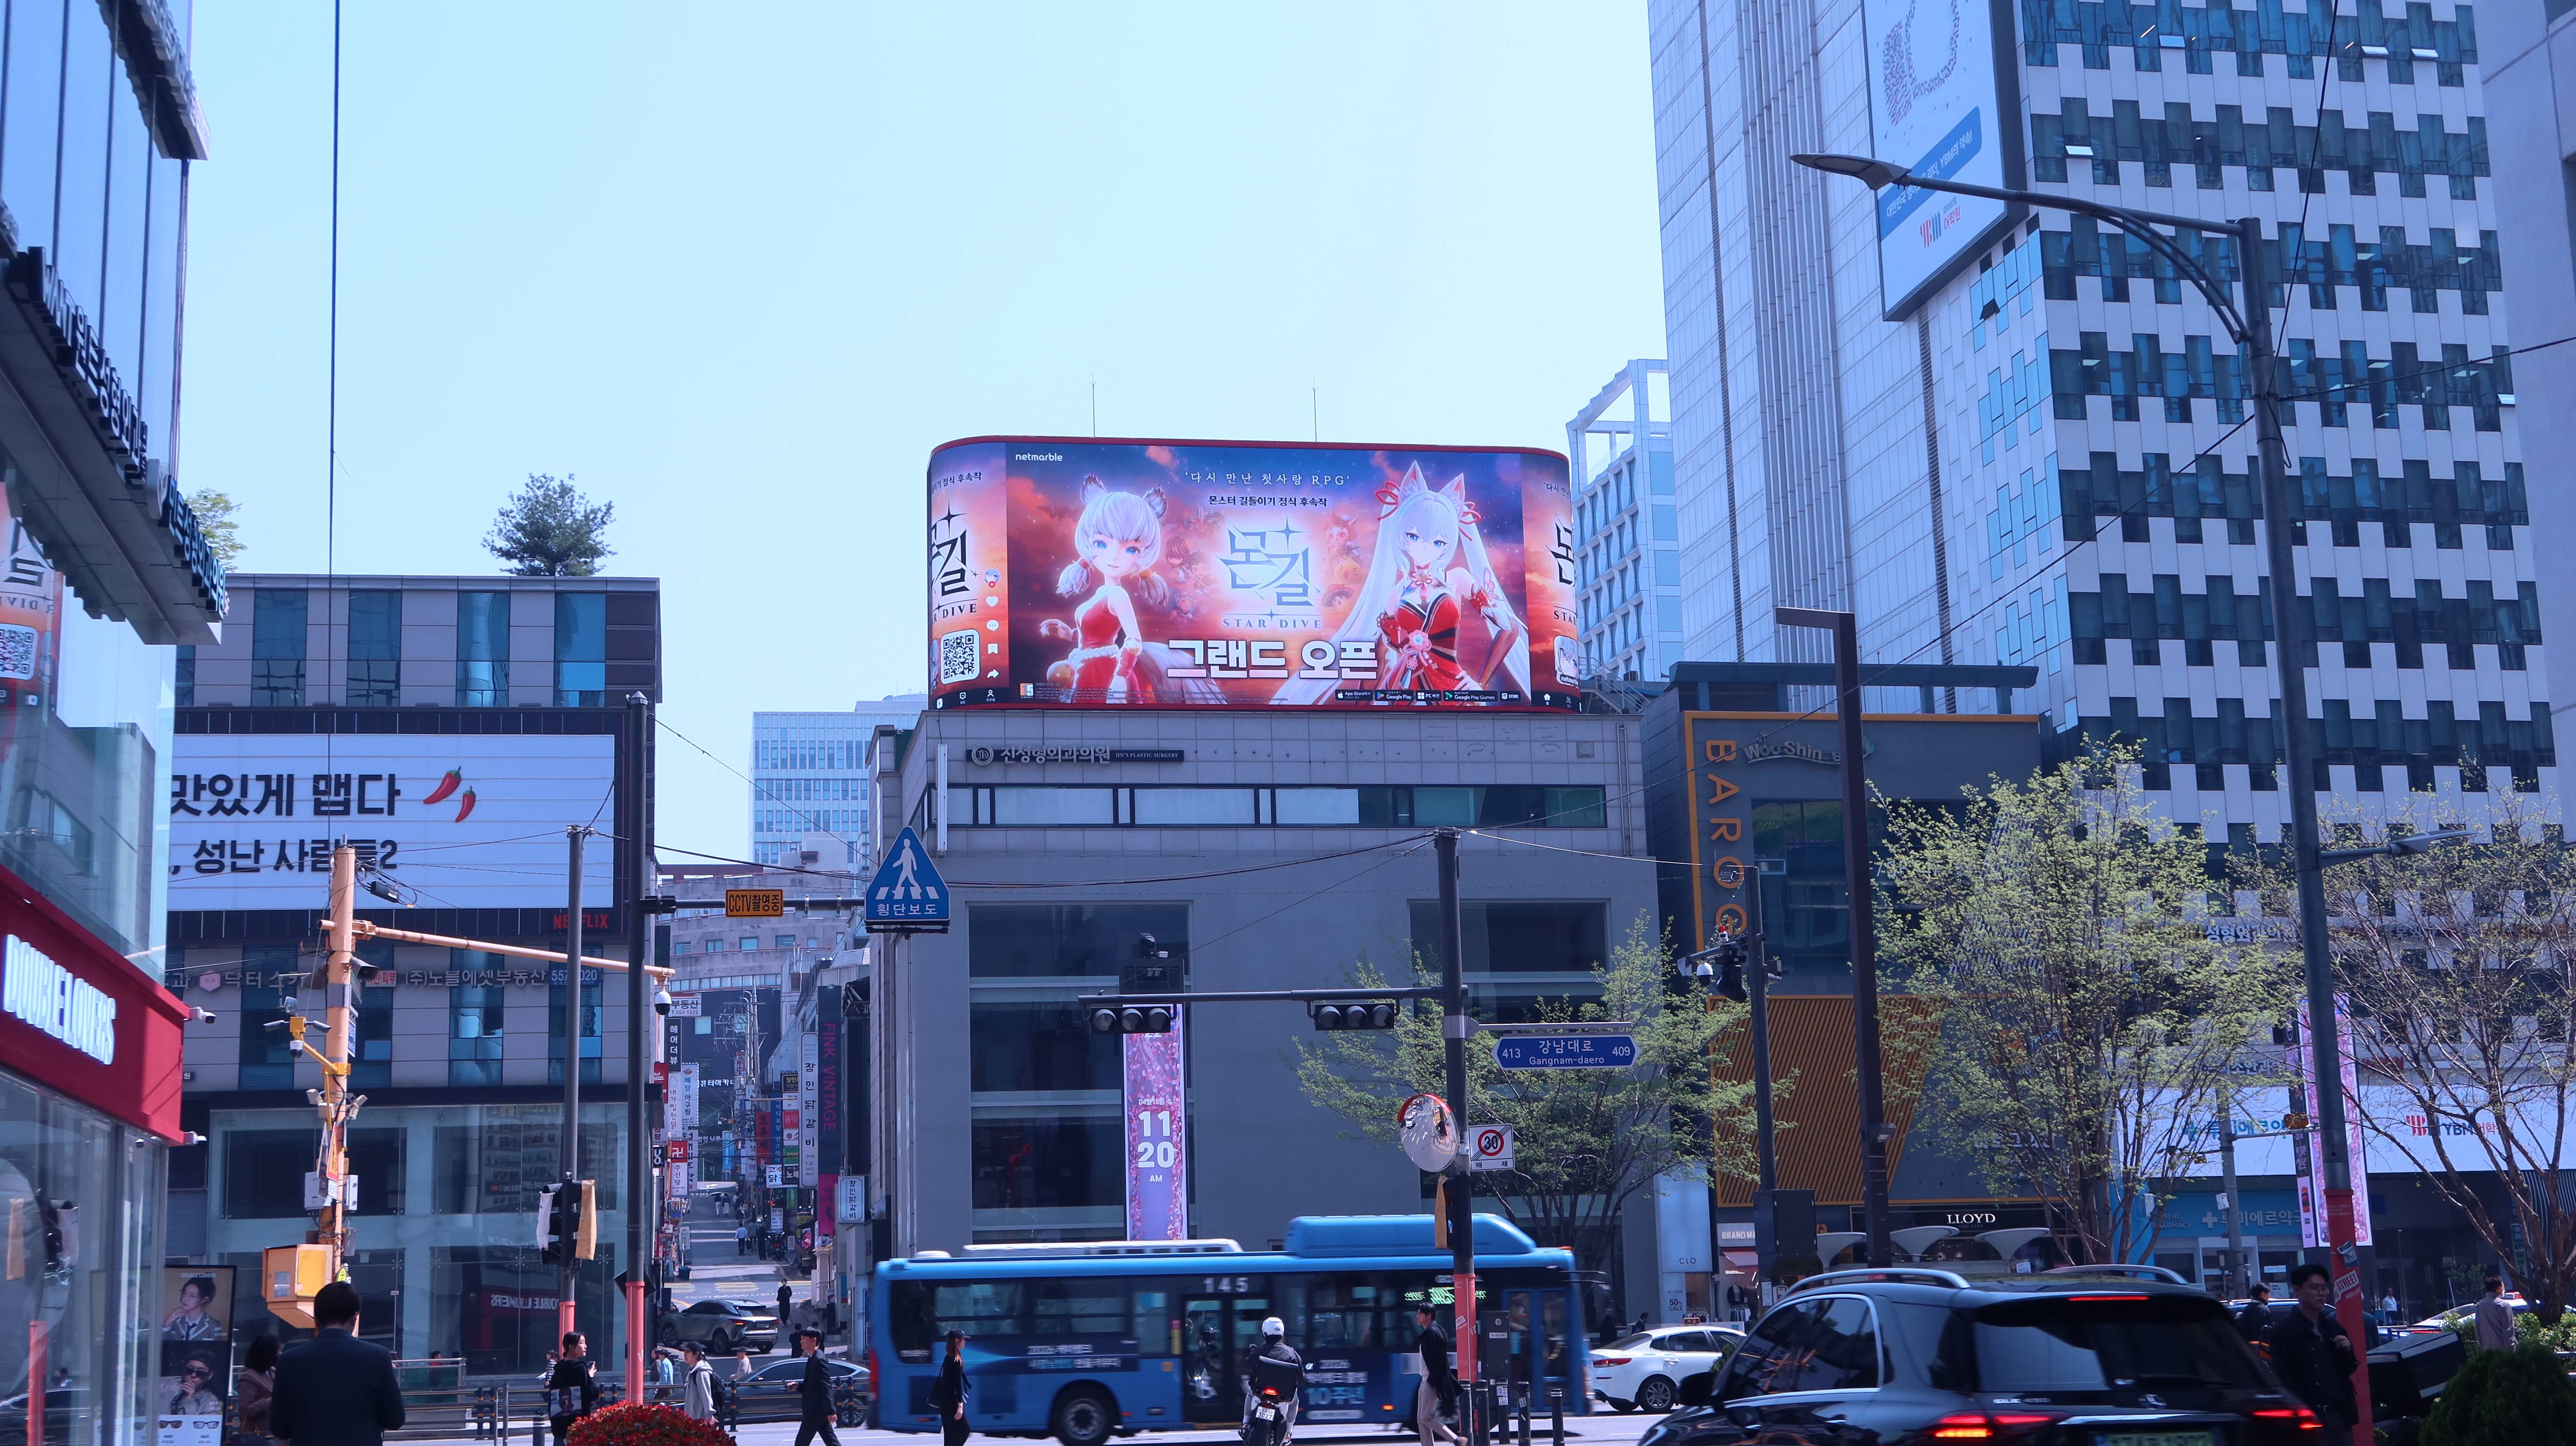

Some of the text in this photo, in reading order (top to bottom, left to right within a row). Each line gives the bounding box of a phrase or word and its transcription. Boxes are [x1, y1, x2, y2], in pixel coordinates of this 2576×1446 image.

[1943, 205, 1961, 230] 어학원
[1015, 453, 1063, 461] netmarble
[943, 475, 955, 487] 정식
[957, 471, 982, 482] 후속작
[1226, 473, 1252, 484] 만난
[1262, 474, 1303, 485] 첫사랑
[1208, 496, 1328, 507] 몬스터 길들이기 정식 후속작
[943, 603, 977, 619] DIVE
[1223, 619, 1321, 629] STAR DIVE
[1167, 639, 1378, 679] 그랜드 오픈
[1000, 745, 1111, 765] 진성형외과의원
[171, 773, 401, 816] 맛있게 맵다
[193, 839, 265, 874] 성난
[729, 894, 781, 912] CCTV촬영중
[877, 903, 937, 916] 횡단보도
[553, 914, 608, 929] NEFLIX
[225, 972, 262, 989] 닥터
[405, 968, 546, 988] (주)노블에셋부동산
[3, 934, 116, 1066] DOUBLE LOVERS
[671, 1000, 699, 1010] 부동산
[669, 1025, 678, 1065] 헤어더뷰
[1539, 1039, 1594, 1054] 강남대로
[1612, 1046, 1631, 1057] 409
[1502, 1048, 1521, 1059] 413
[1529, 1055, 1605, 1067] Gangnam-daero
[823, 1023, 837, 1132] FINK VINTAGE
[805, 1062, 817, 1148] 장인닭갈비
[1138, 1111, 1171, 1137] 11
[1484, 1135, 1498, 1150] 30
[1137, 1141, 1175, 1168] 20
[849, 1180, 857, 1219] 장인닭갈비
[1947, 1213, 1996, 1224] LLOYD
[1203, 1277, 1248, 1293] 145
[2336, 1273, 2358, 1291] STREET
[1257, 1411, 1273, 1420] 3027
